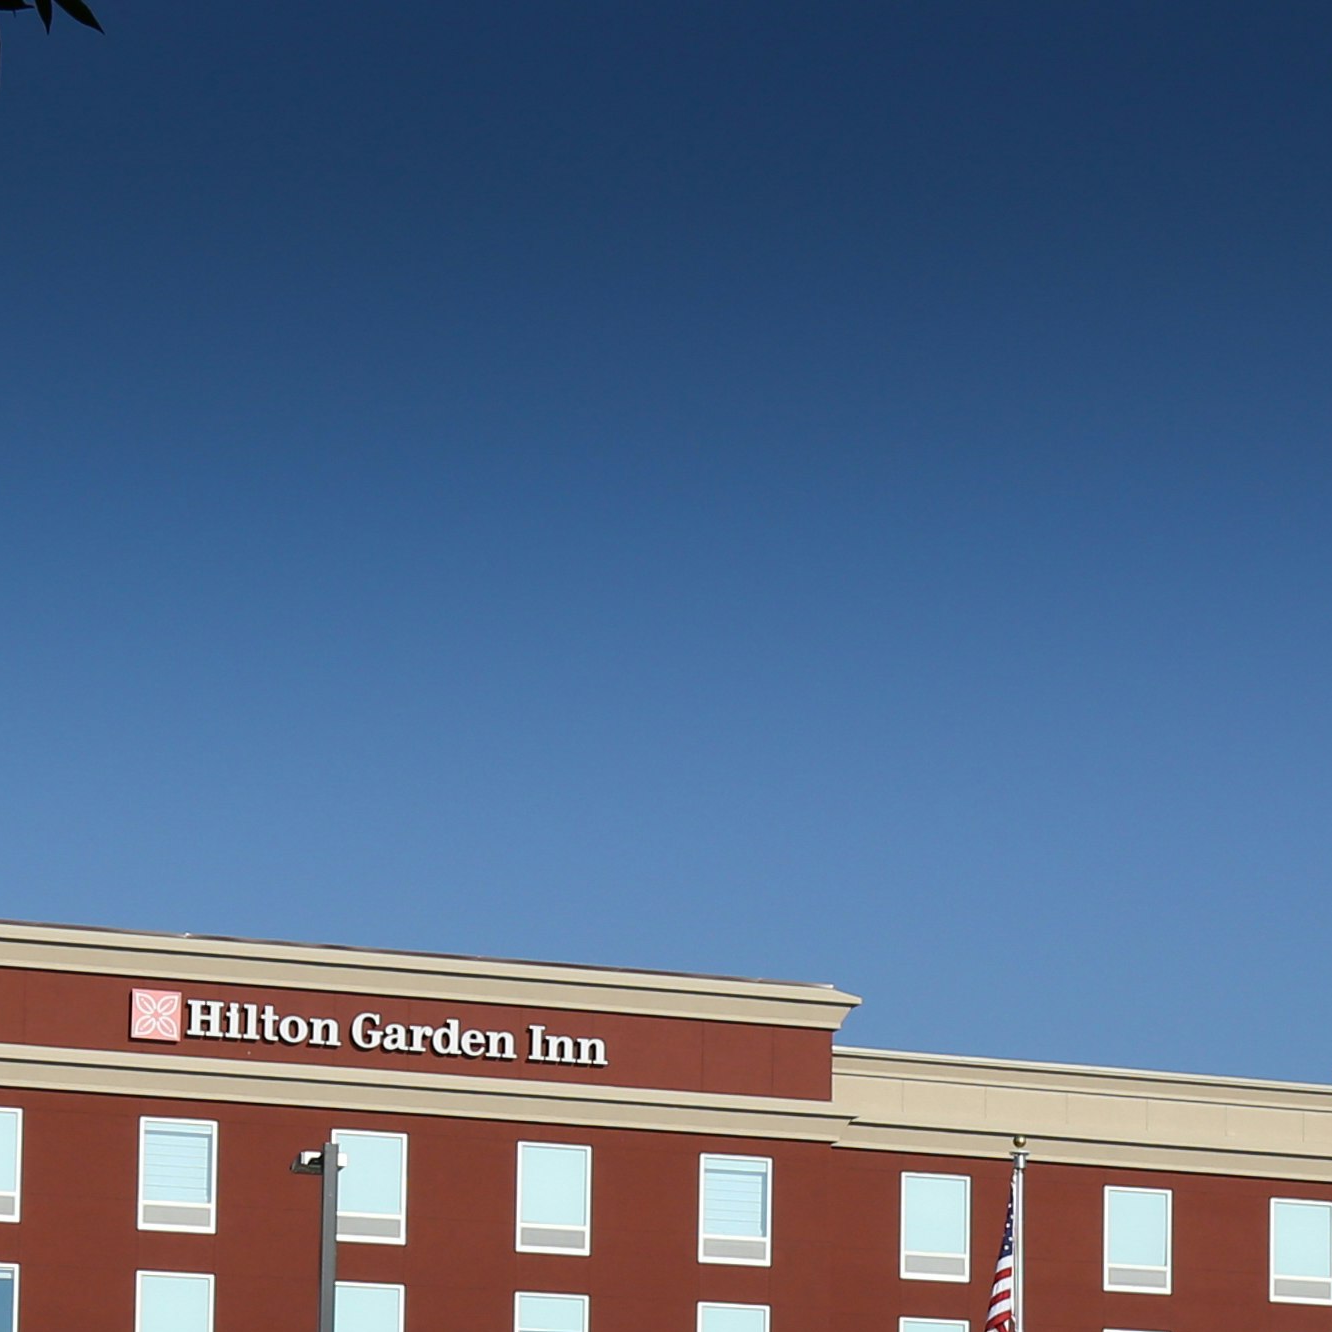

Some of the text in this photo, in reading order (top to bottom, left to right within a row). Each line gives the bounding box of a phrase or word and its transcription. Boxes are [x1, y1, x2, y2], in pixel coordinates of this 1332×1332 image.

[186, 999, 609, 1067] Hilton Garden Inn
